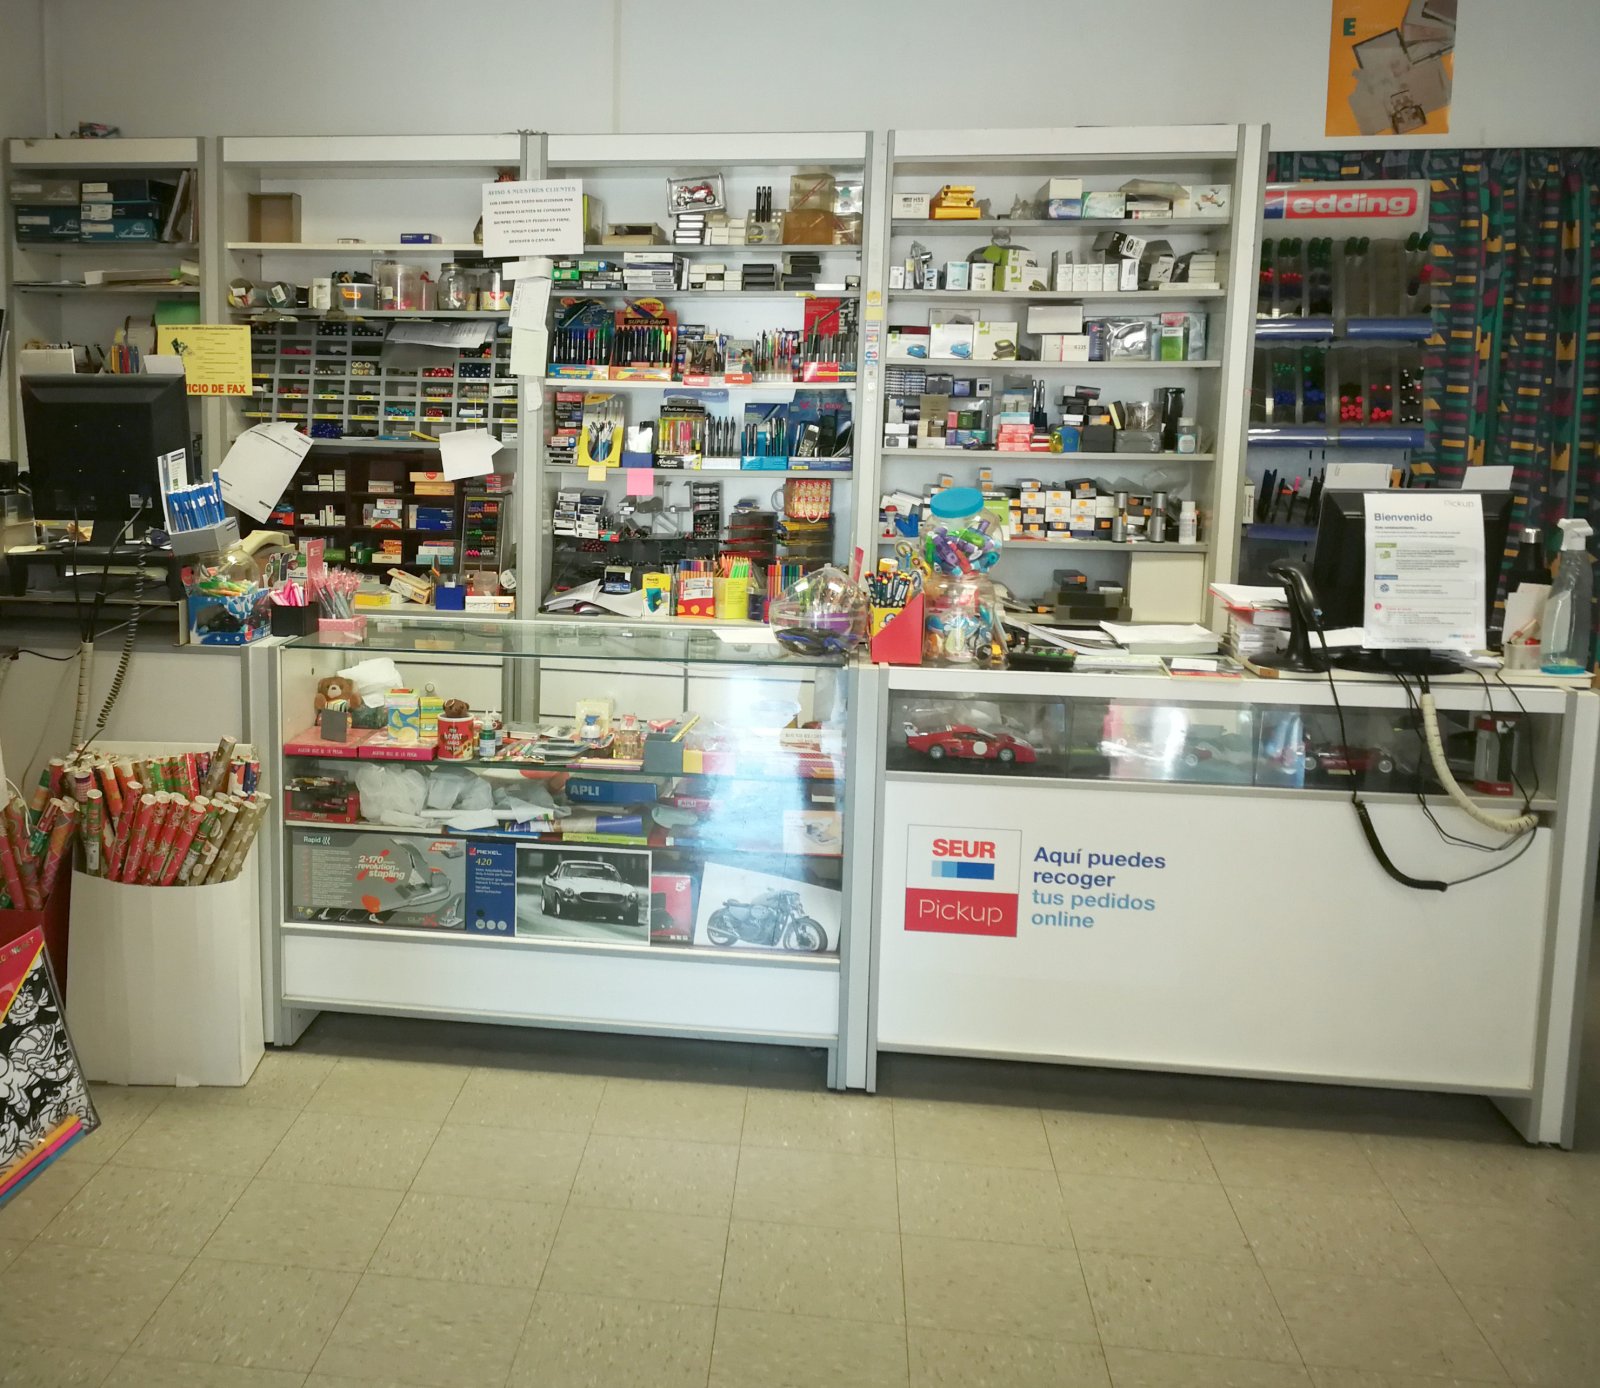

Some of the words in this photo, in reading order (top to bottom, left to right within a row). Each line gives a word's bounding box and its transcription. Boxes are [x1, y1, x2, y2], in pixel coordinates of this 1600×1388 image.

[1343, 18, 1357, 36] E
[1292, 193, 1410, 216] edding
[211, 384, 224, 393] DE
[227, 384, 246, 394] FAX
[1374, 512, 1433, 522] Bienvenido
[570, 785, 600, 796] APLI
[303, 836, 321, 844] Rapid
[932, 838, 996, 859] SEUR
[476, 858, 492, 866] 420
[1033, 846, 1082, 865] Aquí
[1088, 851, 1166, 869] puedes
[357, 863, 396, 871] revolution
[368, 870, 406, 880] stapling
[1033, 870, 1116, 890] recoger
[1032, 890, 1064, 906] tus
[1071, 892, 1156, 912] pedidos
[919, 899, 1003, 926] Pickup
[1031, 911, 1095, 928] online
